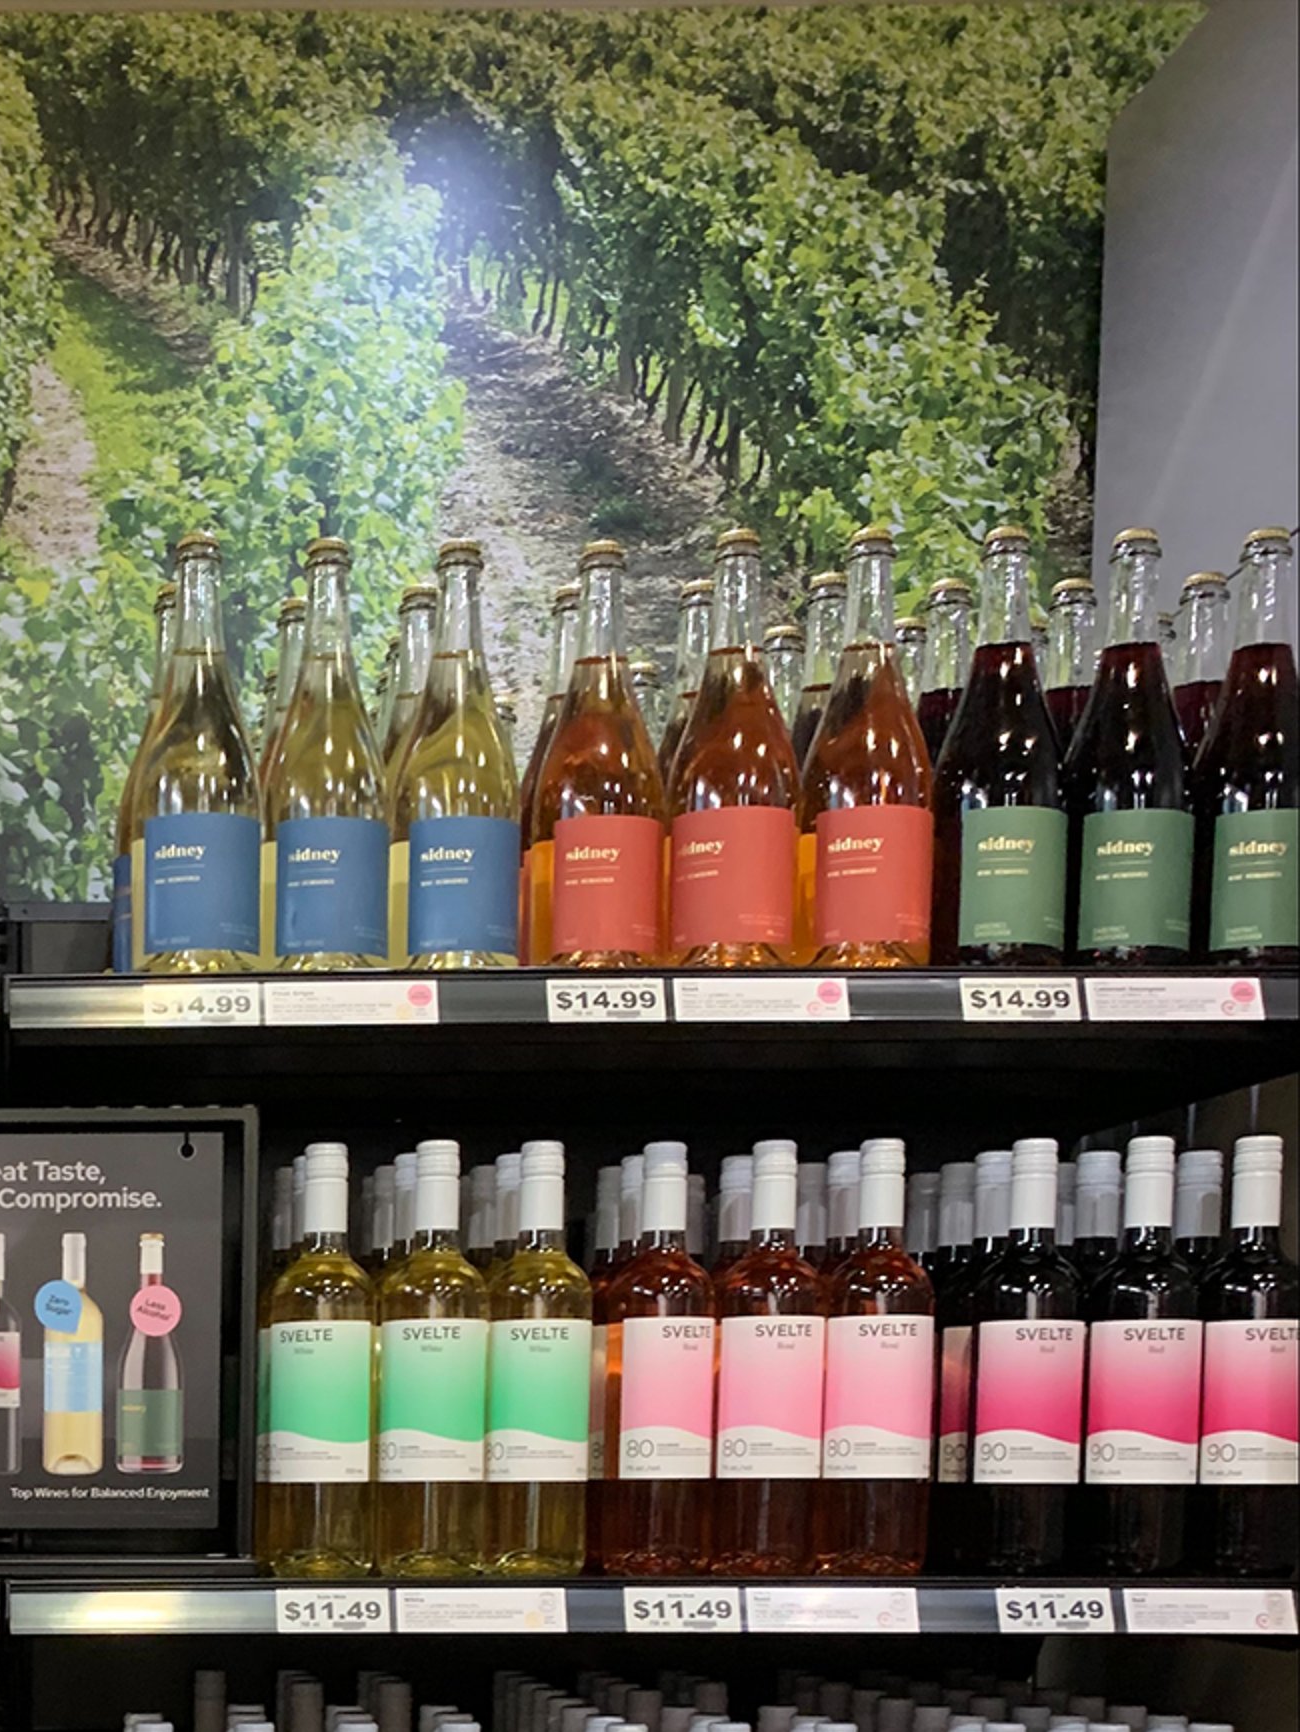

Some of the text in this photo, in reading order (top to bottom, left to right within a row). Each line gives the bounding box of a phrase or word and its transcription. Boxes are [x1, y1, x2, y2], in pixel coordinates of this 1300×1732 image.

[154, 843, 207, 861] sidney
[827, 835, 884, 855] sidney
[977, 836, 1036, 853] sidney
[1097, 839, 1155, 857] sidney
[1229, 839, 1288, 857] sidney
[288, 847, 341, 866] sidney
[420, 846, 476, 864] sidney
[565, 846, 621, 863] sidney
[555, 990, 657, 1011] $14.99
[970, 989, 1071, 1010] $14.99
[32, 1160, 106, 1185] Taste,
[48, 1293, 70, 1306] Zero
[144, 1299, 166, 1311] Less
[280, 1329, 333, 1343] SVELTE
[403, 1326, 461, 1341] SVELTE
[511, 1327, 569, 1341] SVELTE
[661, 1326, 710, 1339] SVELTE
[755, 1324, 813, 1337] SVELTE
[859, 1323, 917, 1337] SVELTE
[1016, 1328, 1073, 1341] SVELTE
[1123, 1328, 1186, 1341] SVELTE
[980, 1443, 1006, 1462] 90
[1090, 1443, 1114, 1462] 90
[1206, 1443, 1236, 1462] 90
[10, 1487, 209, 1501] Top Wines for Balanced Enjoyment
[284, 1600, 381, 1621] $11.49
[633, 1599, 731, 1620] $11.49
[1006, 1600, 1104, 1620] $11.49
